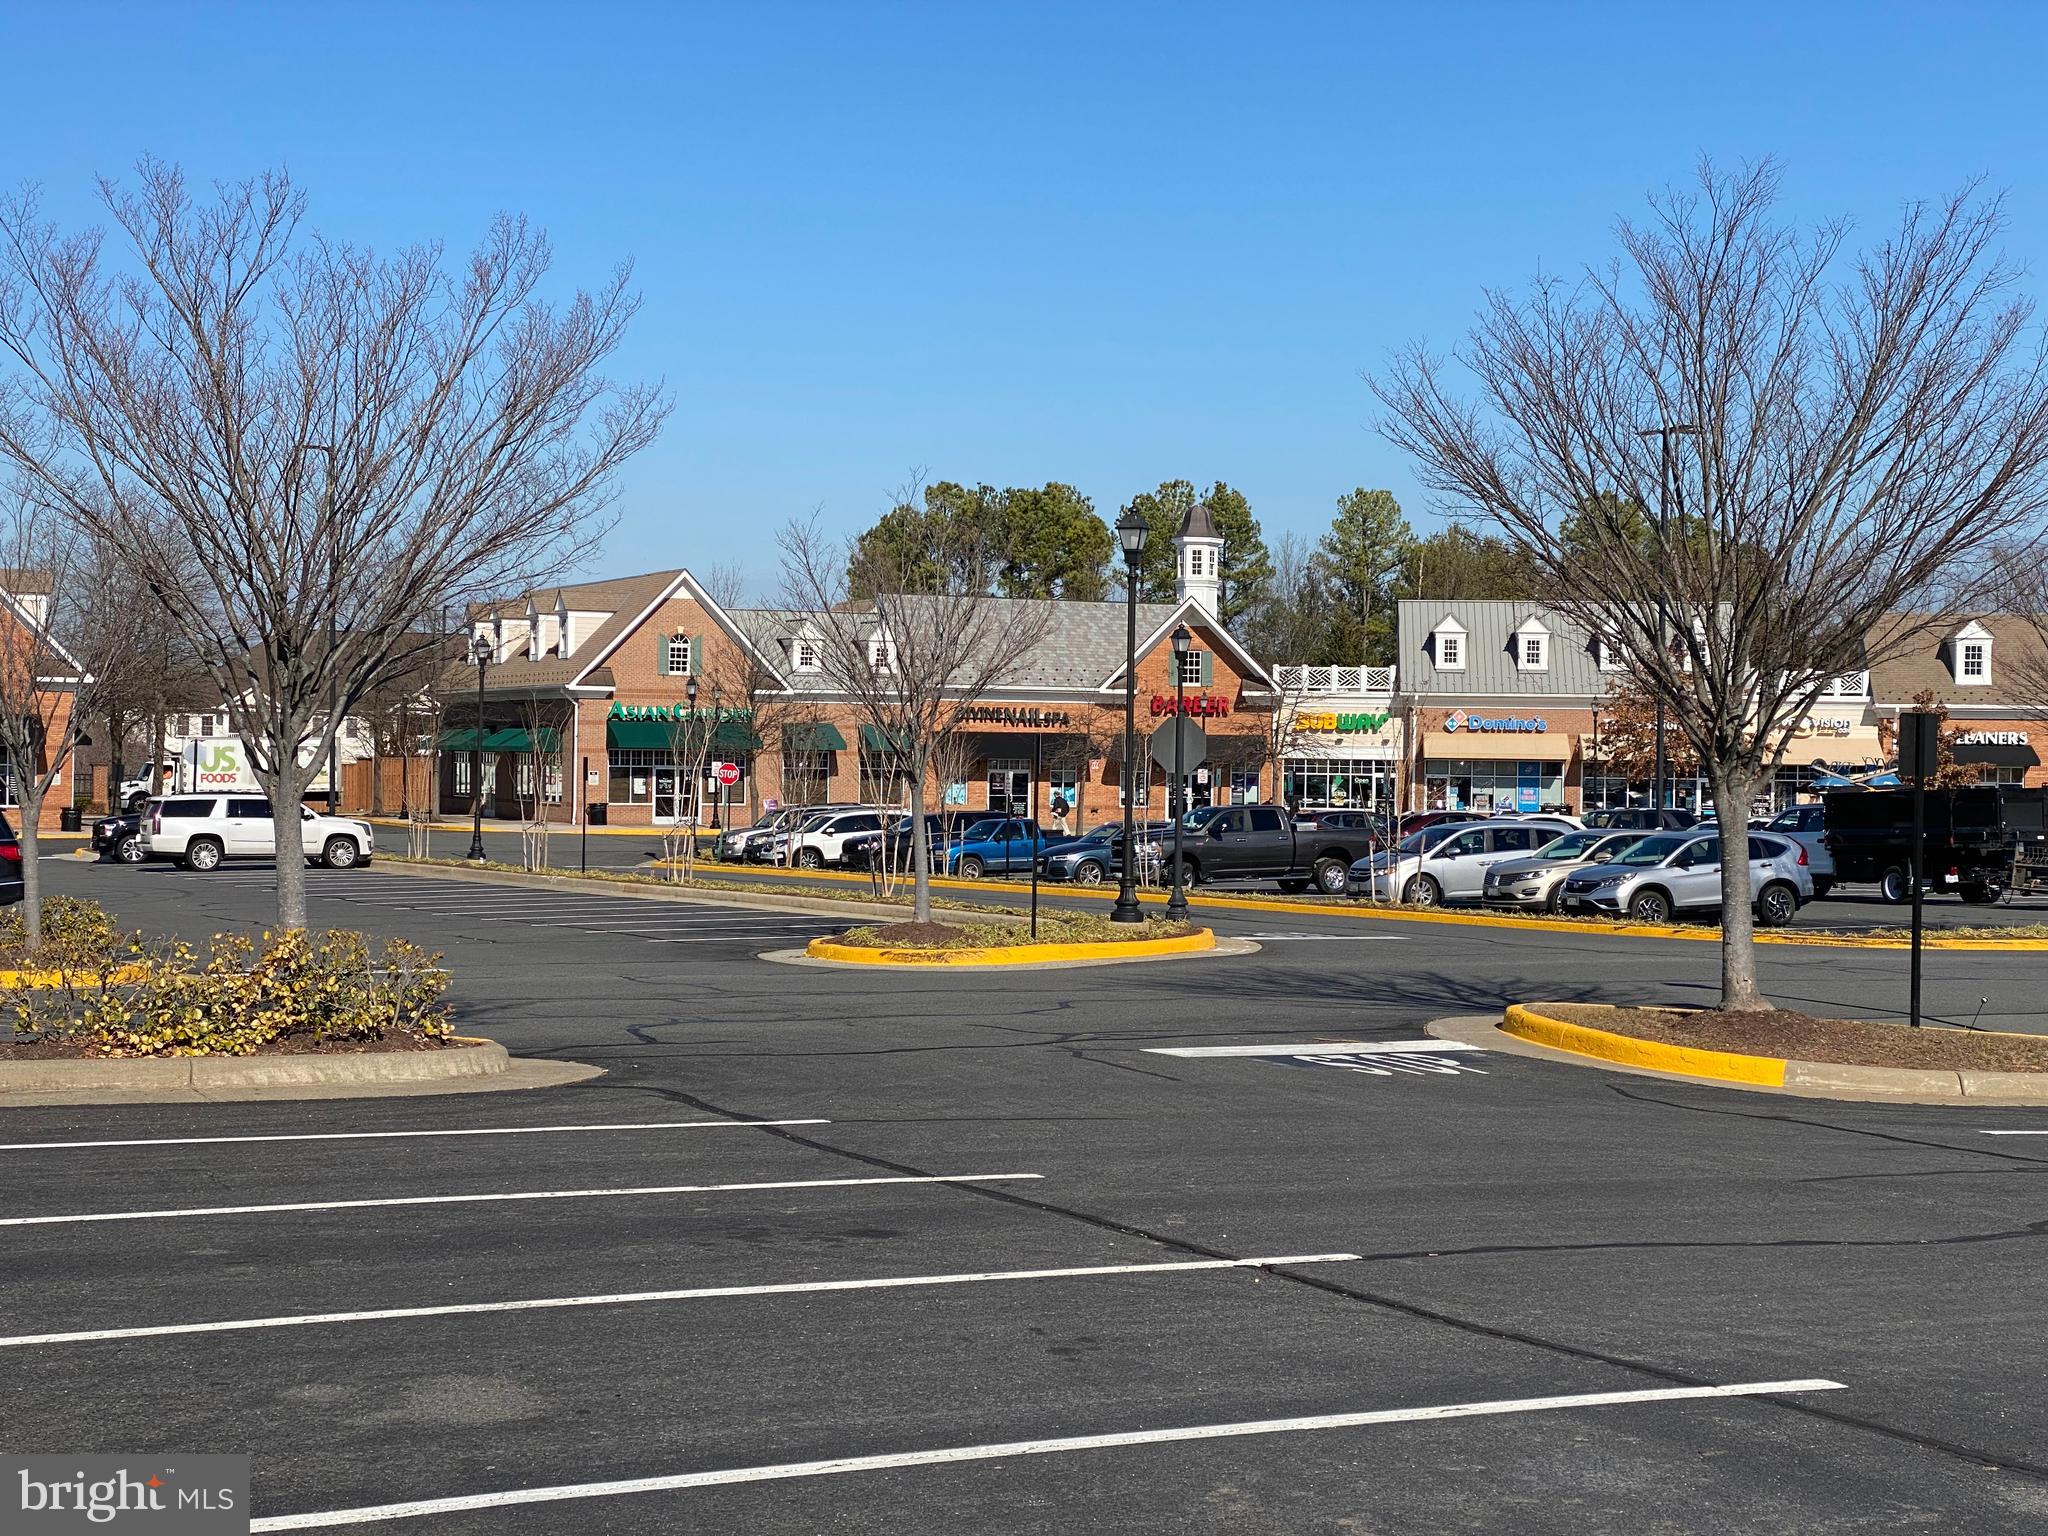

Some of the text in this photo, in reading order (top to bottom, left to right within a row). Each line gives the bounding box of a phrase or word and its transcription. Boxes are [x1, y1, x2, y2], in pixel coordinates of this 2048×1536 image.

[607, 700, 671, 719] ASIAN
[1295, 711, 1393, 732] SUBWAY
[1468, 714, 1547, 731] Domino's
[1944, 731, 2028, 745] LEANERS
[201, 773, 236, 783] FOODS
[719, 769, 738, 779] STOP
